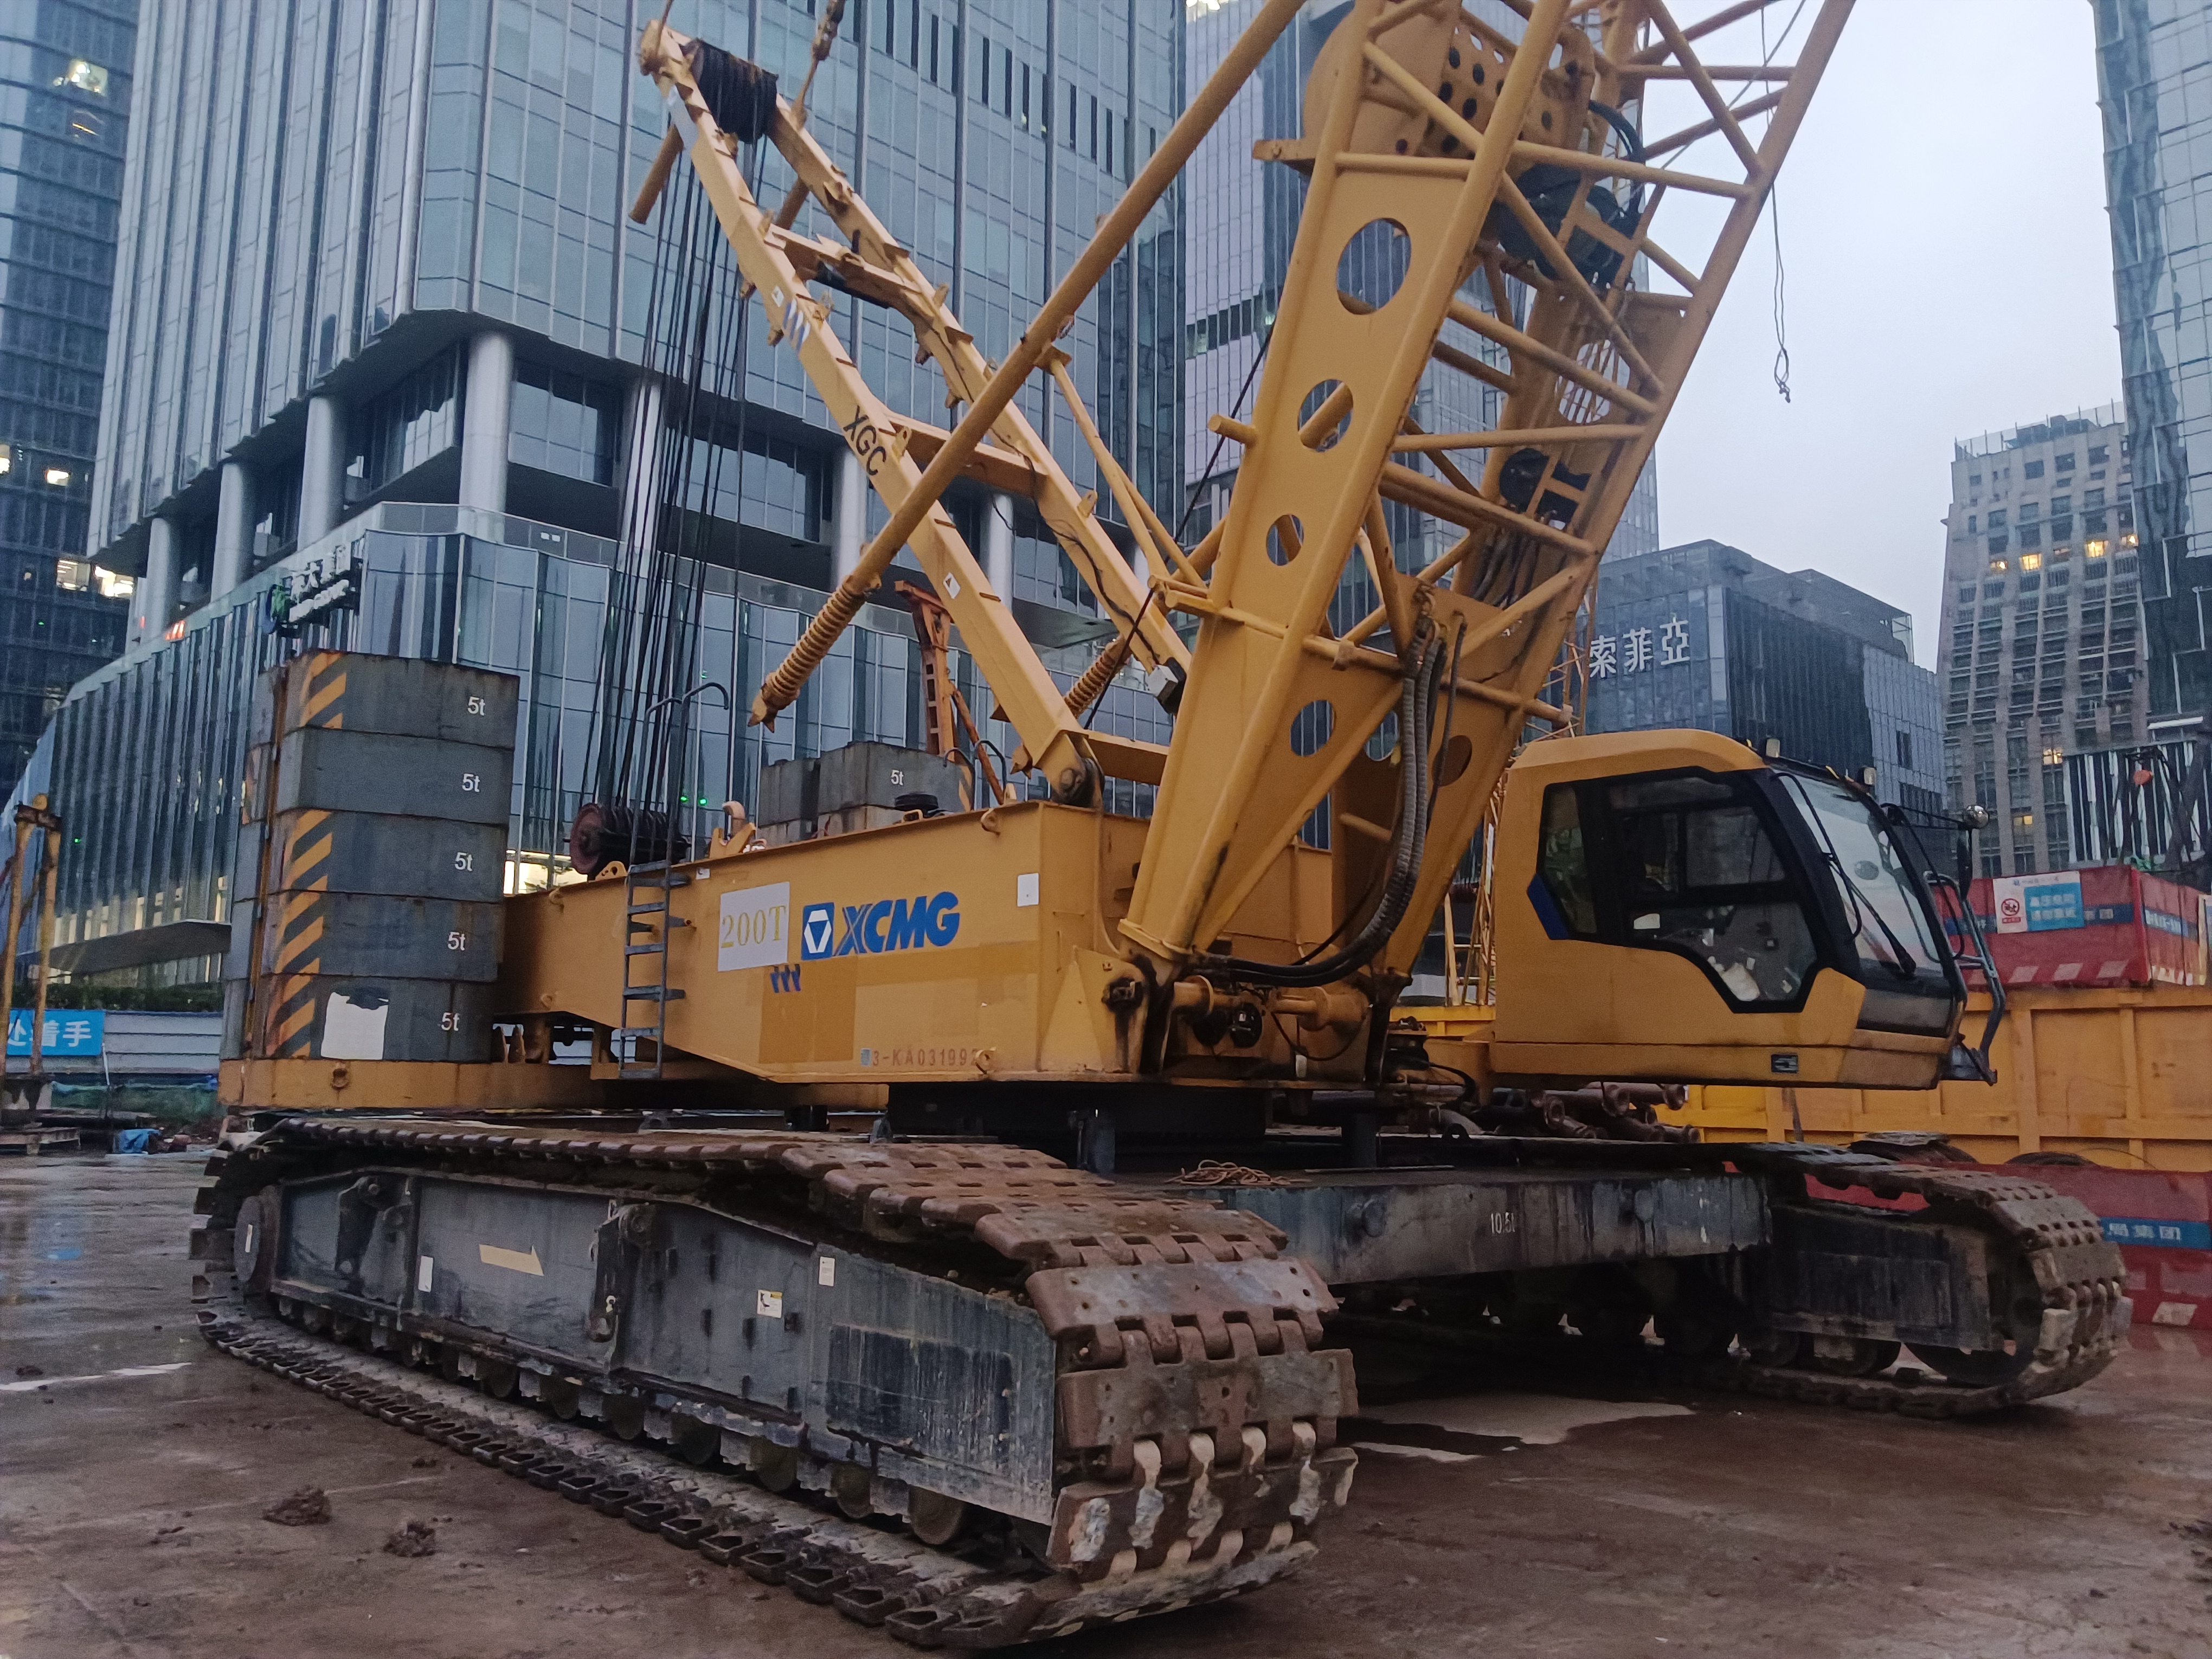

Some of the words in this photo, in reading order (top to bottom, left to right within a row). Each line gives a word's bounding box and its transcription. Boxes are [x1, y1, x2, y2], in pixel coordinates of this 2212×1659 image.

[843, 405, 887, 477] XGC
[467, 696, 486, 716] 5t
[462, 773, 480, 793] 5t
[891, 769, 904, 786] 5t
[454, 852, 473, 871] 5t
[721, 905, 787, 948] 200T
[832, 891, 960, 957] XCMG
[447, 931, 466, 951] 5t
[441, 1012, 460, 1031] 5t
